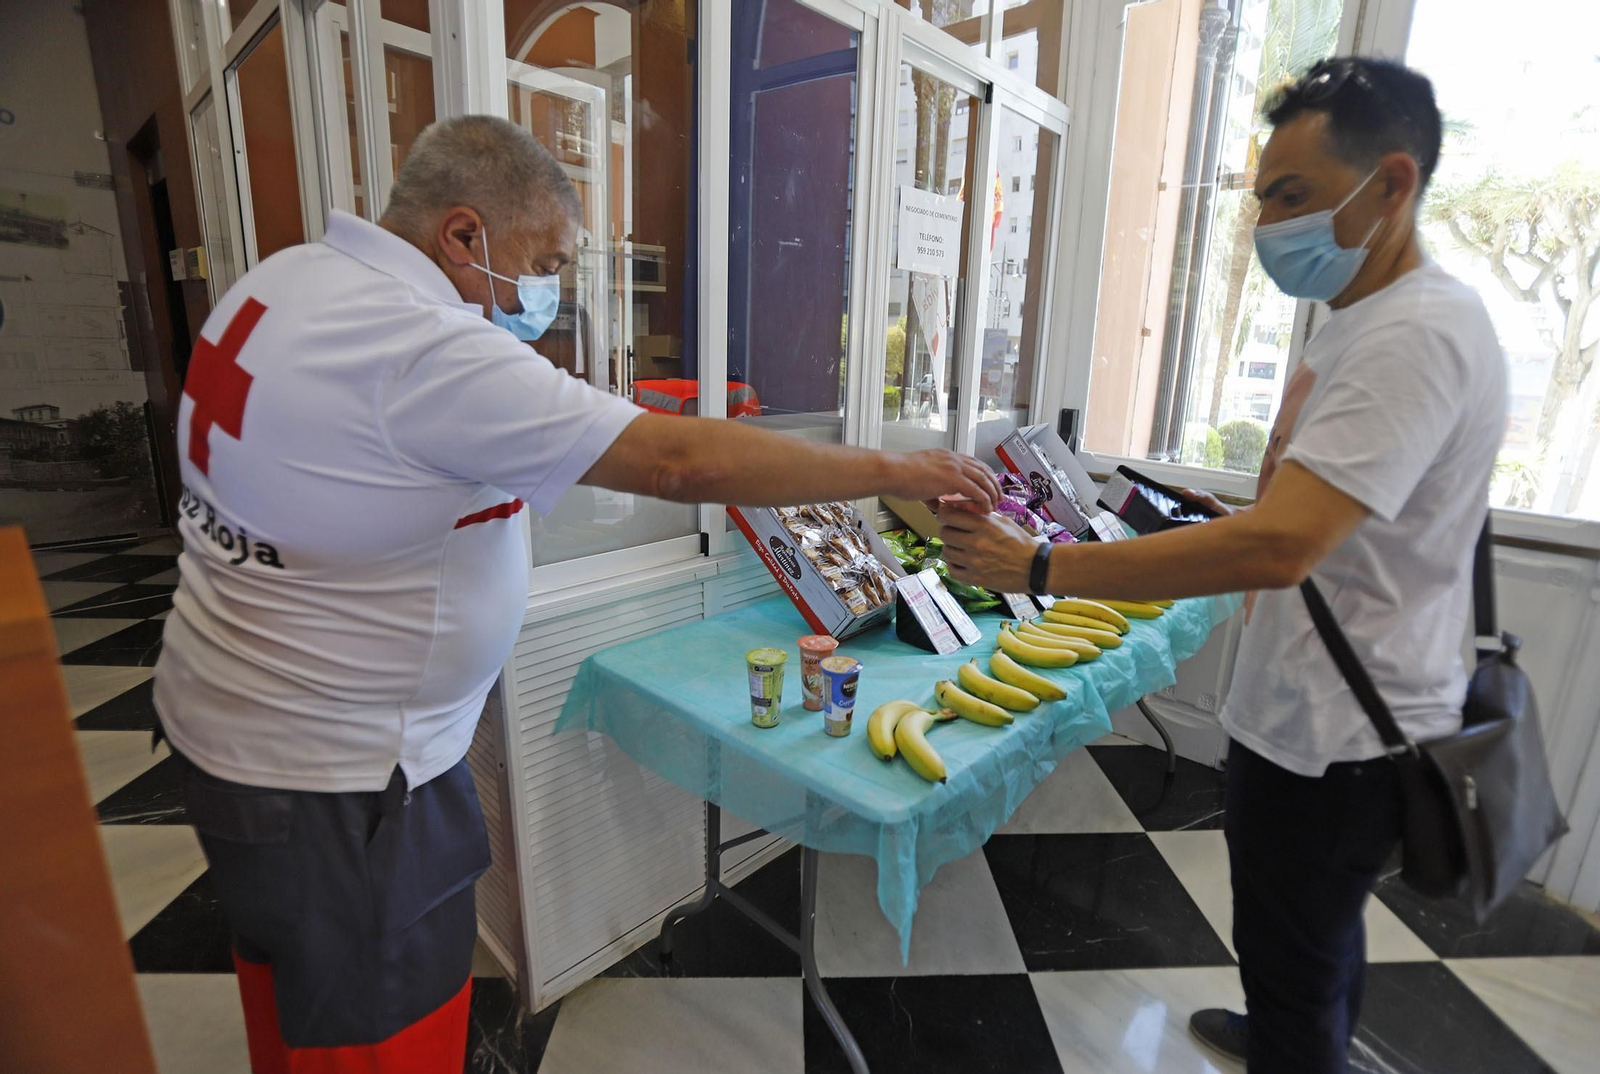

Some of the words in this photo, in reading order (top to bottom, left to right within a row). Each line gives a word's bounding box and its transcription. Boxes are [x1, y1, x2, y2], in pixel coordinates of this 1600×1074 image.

[905, 205, 930, 217] NEGOCIADO
[934, 212, 958, 222] CEMENTERIO
[917, 246, 926, 255] 959
[926, 247, 936, 256] 210
[935, 248, 945, 258] 573
[200, 500, 285, 569] Roja
